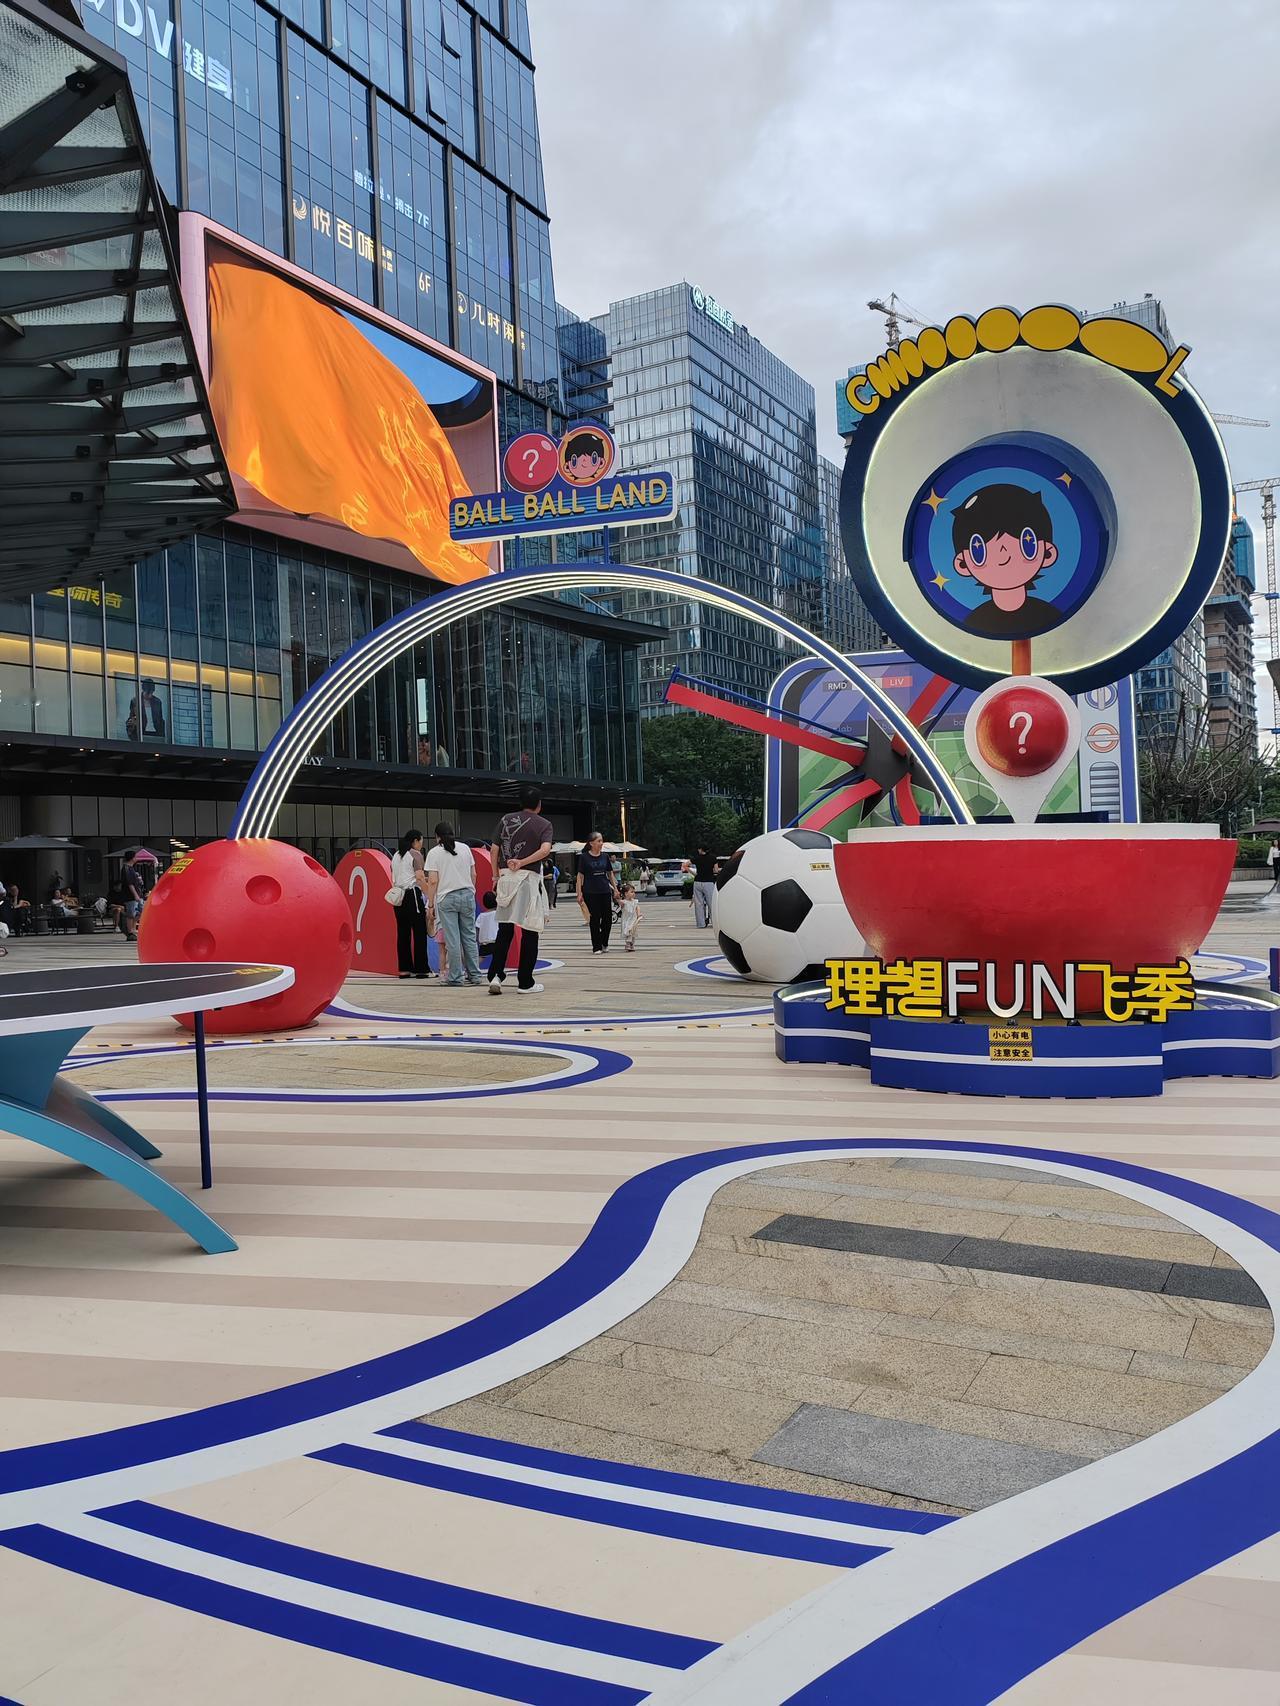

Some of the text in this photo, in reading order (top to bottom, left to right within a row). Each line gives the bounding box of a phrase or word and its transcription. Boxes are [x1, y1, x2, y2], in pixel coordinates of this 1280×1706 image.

[182, 40, 232, 100] 健身
[416, 209, 430, 228] 7F
[418, 272, 432, 294] 6F
[454, 478, 667, 527] BALL BALL LAND
[827, 681, 848, 691] RMD
[889, 678, 905, 686] LIV
[992, 1030, 1030, 1040] 小心有电
[993, 1048, 1030, 1058] 注意安全
